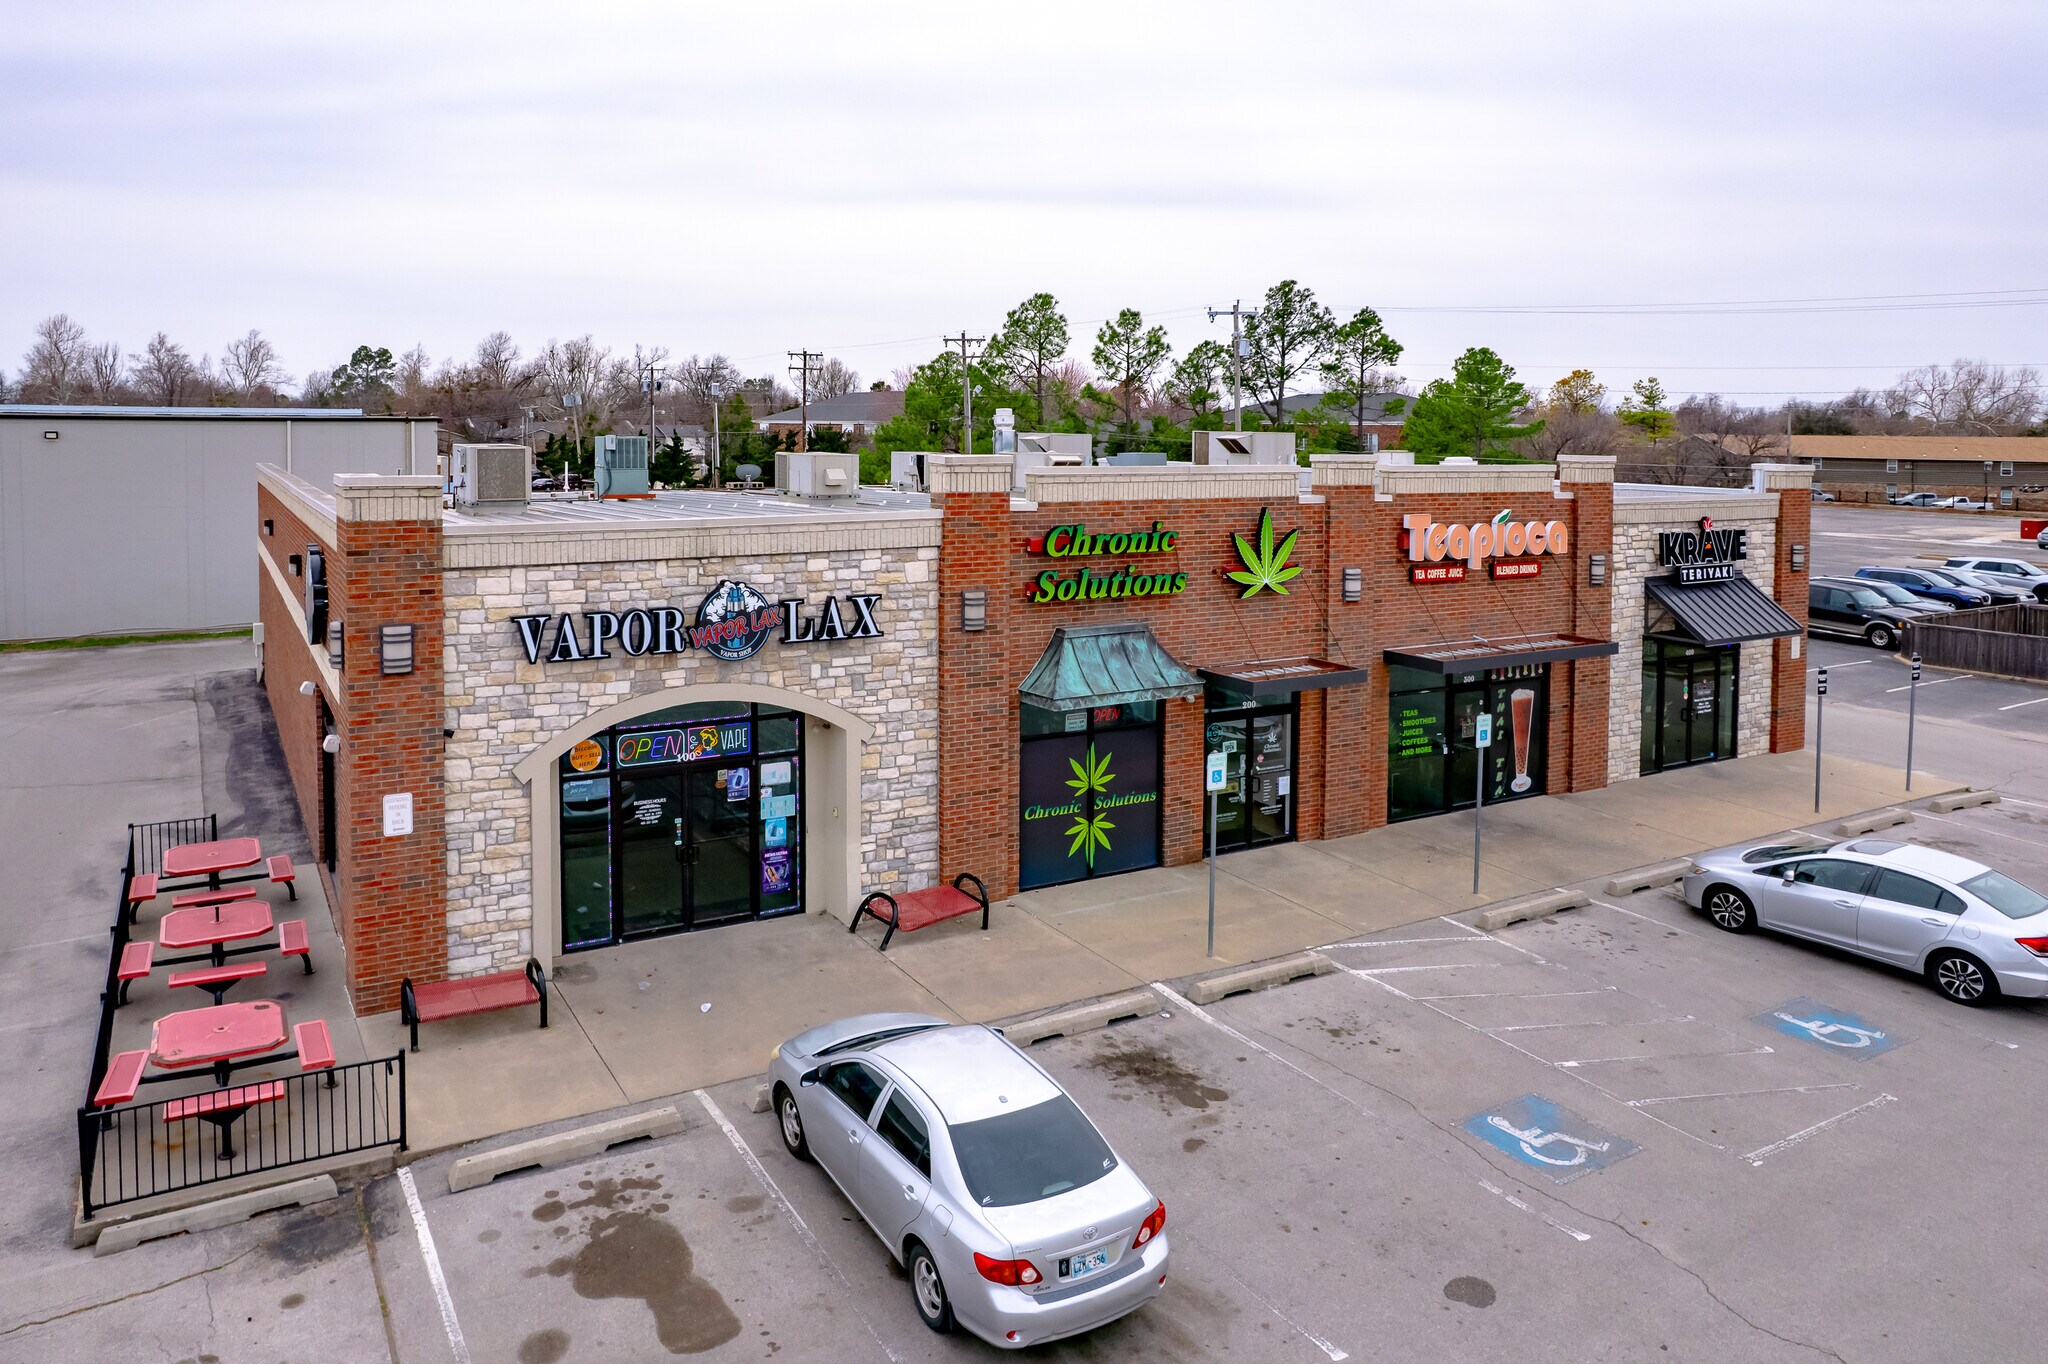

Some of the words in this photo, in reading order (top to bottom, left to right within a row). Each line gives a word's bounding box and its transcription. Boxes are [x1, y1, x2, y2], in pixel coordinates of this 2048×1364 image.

[1045, 521, 1178, 557] Chronic
[1404, 510, 1568, 569] Teapioca
[1659, 528, 1746, 566] KRAVE
[1415, 569, 1425, 579] TEA
[1427, 569, 1446, 578] COFFEE
[1448, 568, 1463, 577] JUICE
[1496, 566, 1518, 575] BLENDED
[1519, 564, 1538, 574] DRINKS
[1682, 566, 1733, 580] TERIYAKI
[1034, 565, 1188, 602] Solutions
[512, 607, 686, 664] VAPOR
[780, 594, 884, 644] LAX
[689, 616, 749, 648] VAPOR
[751, 606, 782, 631] LAX
[720, 650, 738, 658] VAPOR
[739, 647, 752, 657] SHOP
[1242, 700, 1256, 708] 200
[1094, 707, 1120, 723] OPEN
[1402, 709, 1418, 717] TEAS
[1402, 716, 1436, 727] SMOOTHIES
[721, 727, 747, 750] VAPE
[1402, 728, 1423, 736] JUICES
[620, 735, 682, 760] OPEN
[1402, 737, 1428, 746] COFFEES
[677, 752, 696, 762] 100
[1415, 746, 1432, 754] MORE
[1094, 791, 1157, 810] Solutions
[1024, 800, 1082, 820] Chronic
